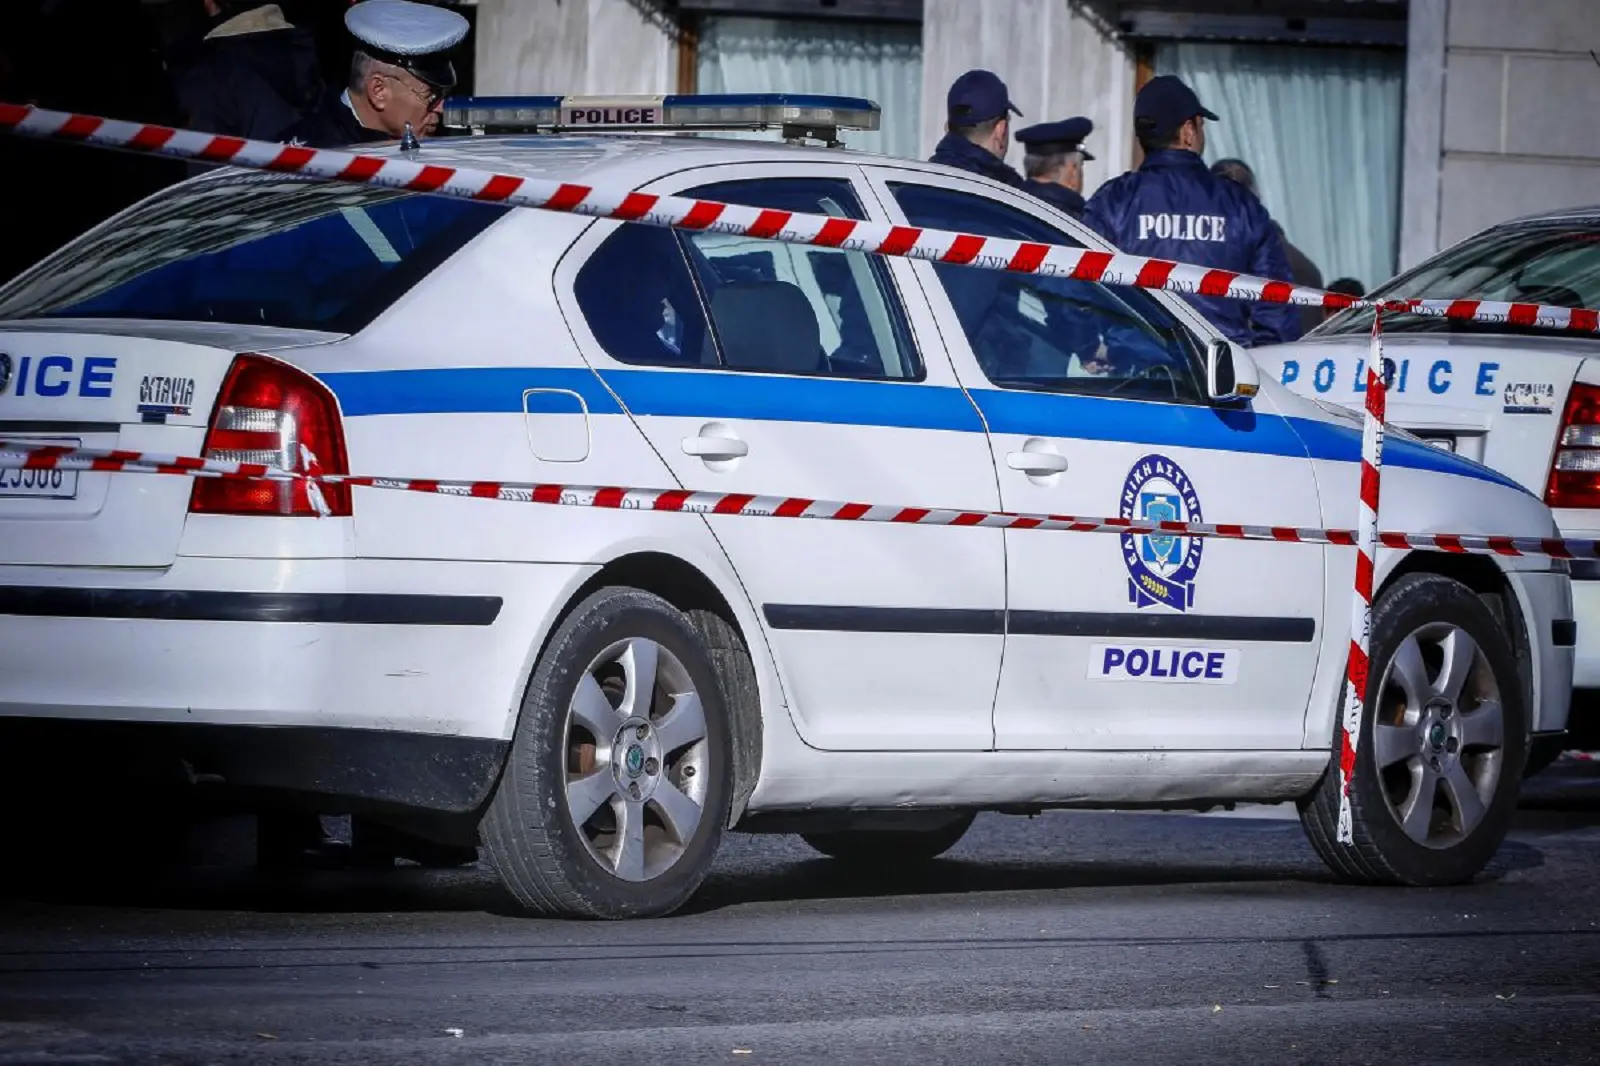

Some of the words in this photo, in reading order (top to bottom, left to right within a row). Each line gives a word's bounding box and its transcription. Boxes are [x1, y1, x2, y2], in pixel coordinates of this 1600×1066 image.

[570, 109, 655, 124] POLICE
[1137, 213, 1226, 242] POLICE
[15, 356, 118, 397] ICE
[1281, 358, 1500, 396] POLICE
[1122, 461, 1153, 566] ΕΛΗΝΙΚΗ
[1102, 647, 1226, 679] POLICE
